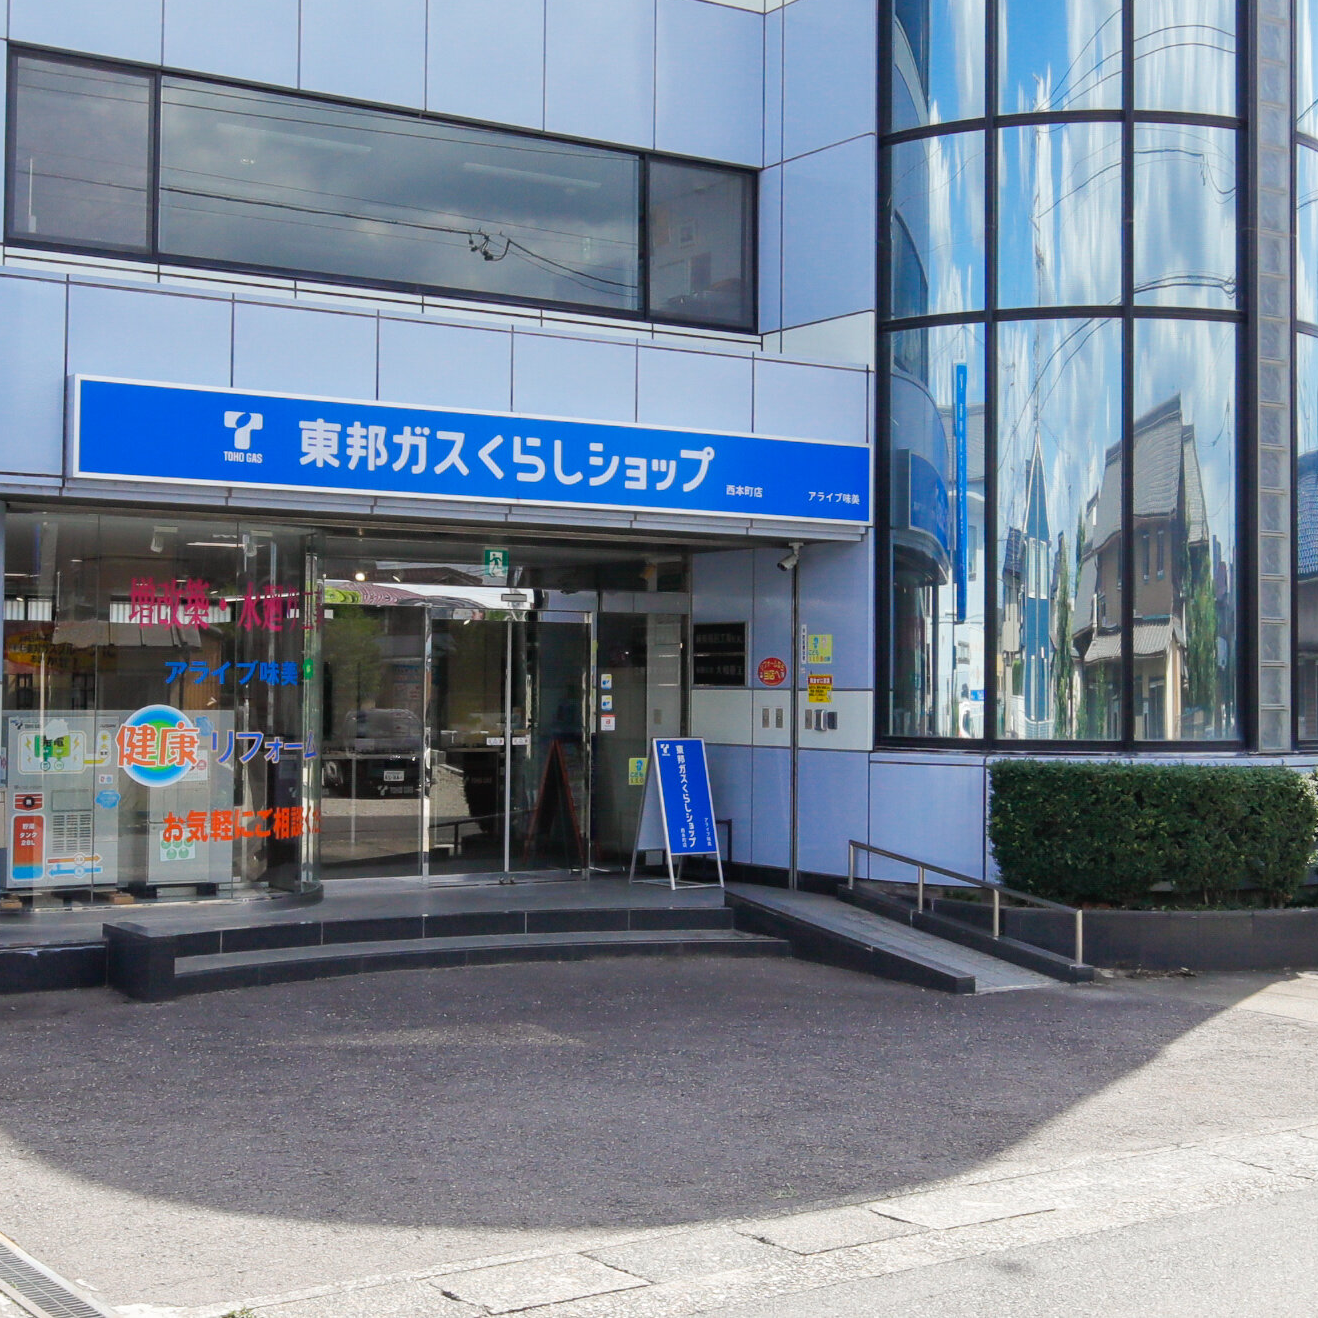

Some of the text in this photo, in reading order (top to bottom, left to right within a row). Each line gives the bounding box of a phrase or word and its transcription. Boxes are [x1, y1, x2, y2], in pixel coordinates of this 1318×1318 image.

[223, 450, 263, 464] TOHO GAS
[298, 418, 715, 492] 東邦ガスくらしショップ
[726, 484, 860, 505] 西本町店 アライブ味美
[165, 660, 299, 686] アライブ味美
